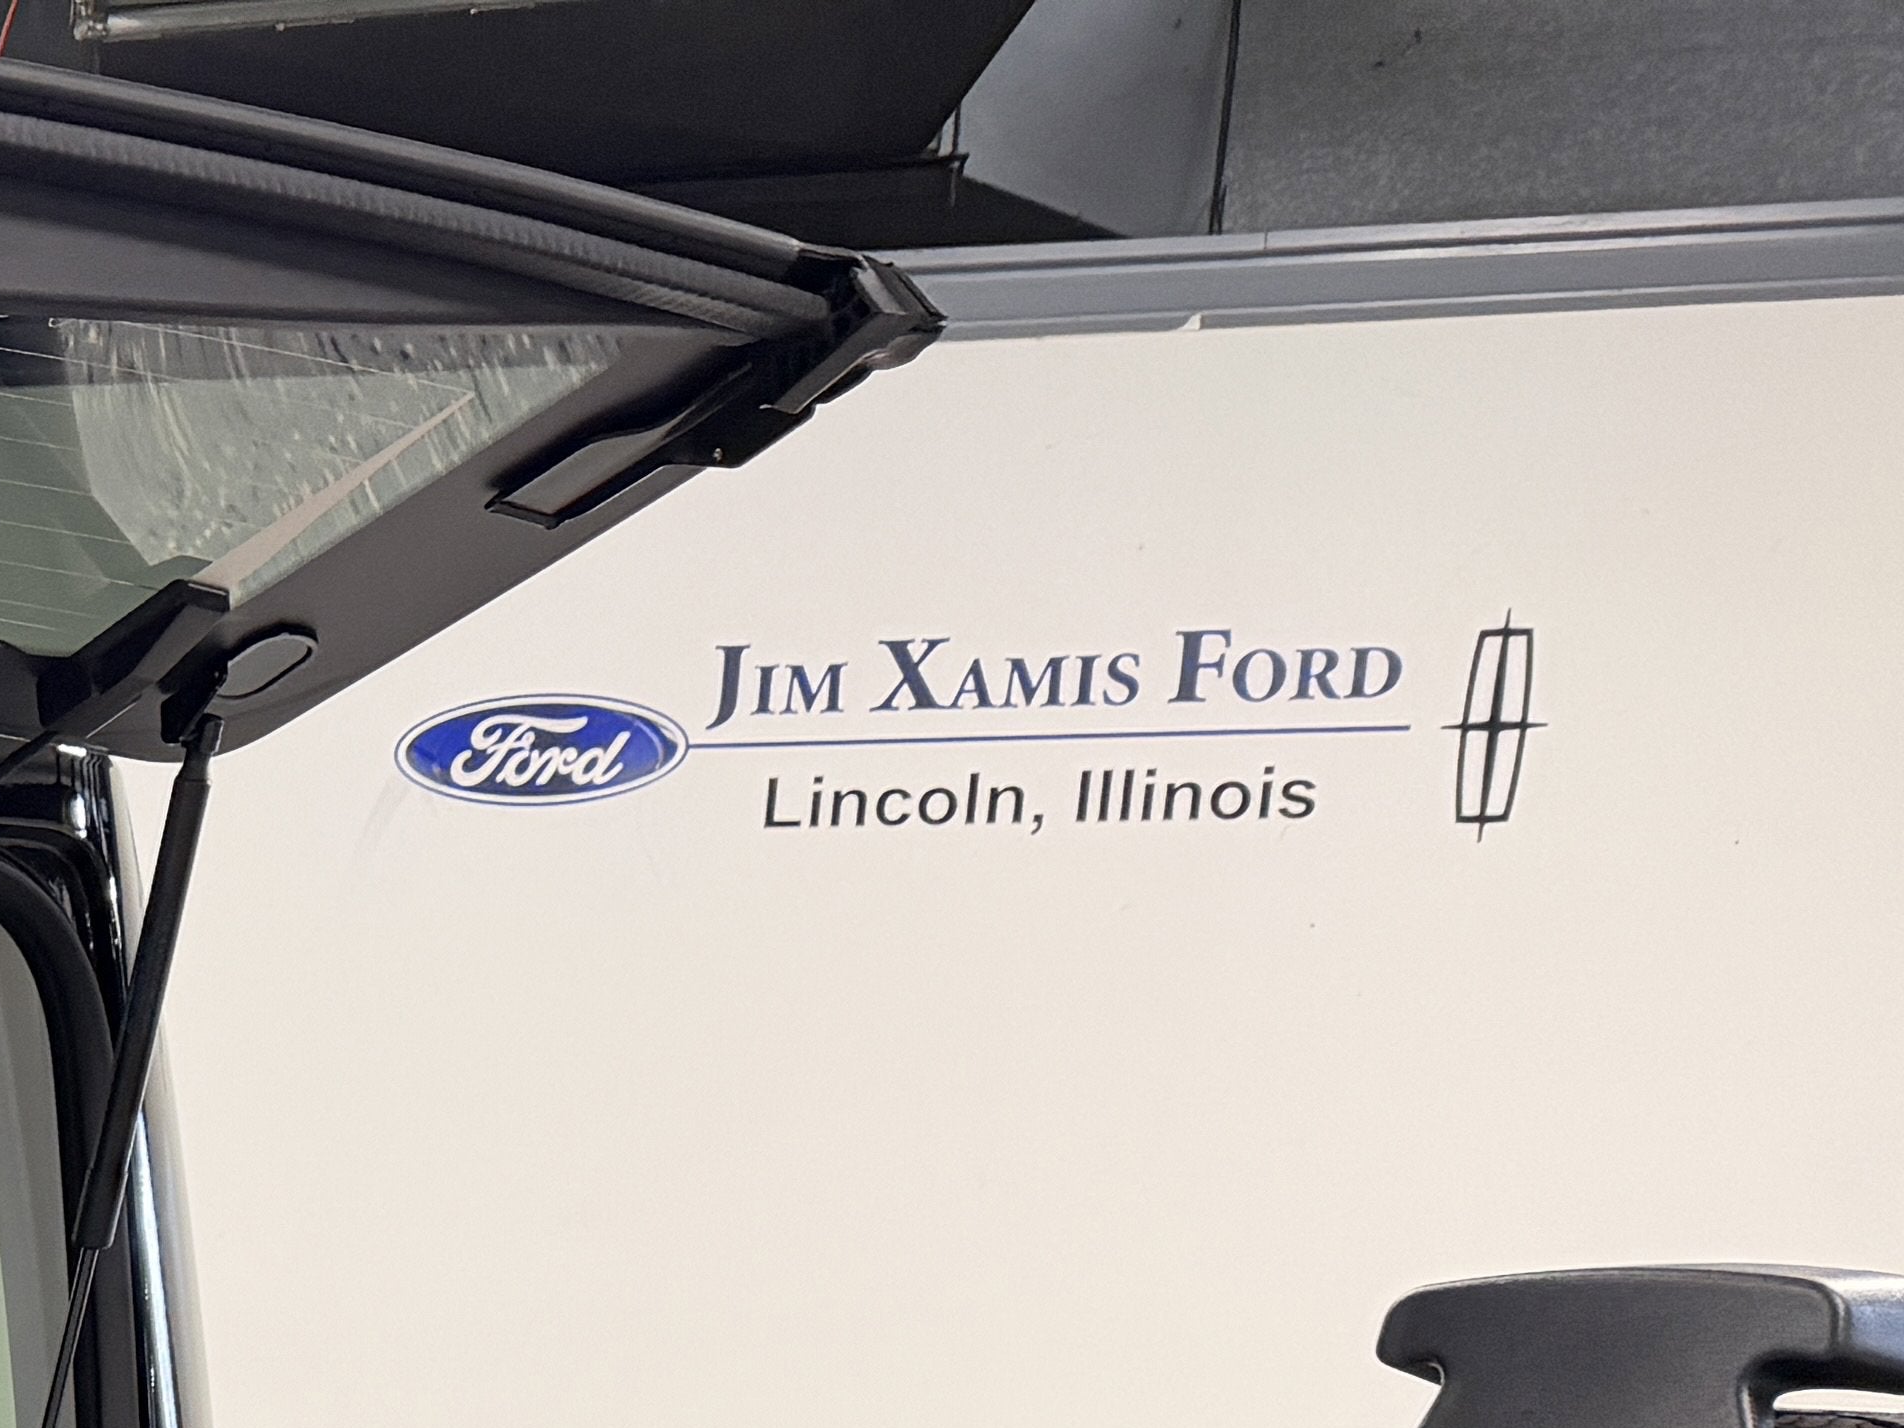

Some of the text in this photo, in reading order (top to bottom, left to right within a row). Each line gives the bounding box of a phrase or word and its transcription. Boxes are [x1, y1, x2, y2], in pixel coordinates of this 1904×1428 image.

[450, 713, 631, 788] Ford
[763, 766, 1316, 835] Lincoln, Illinois
